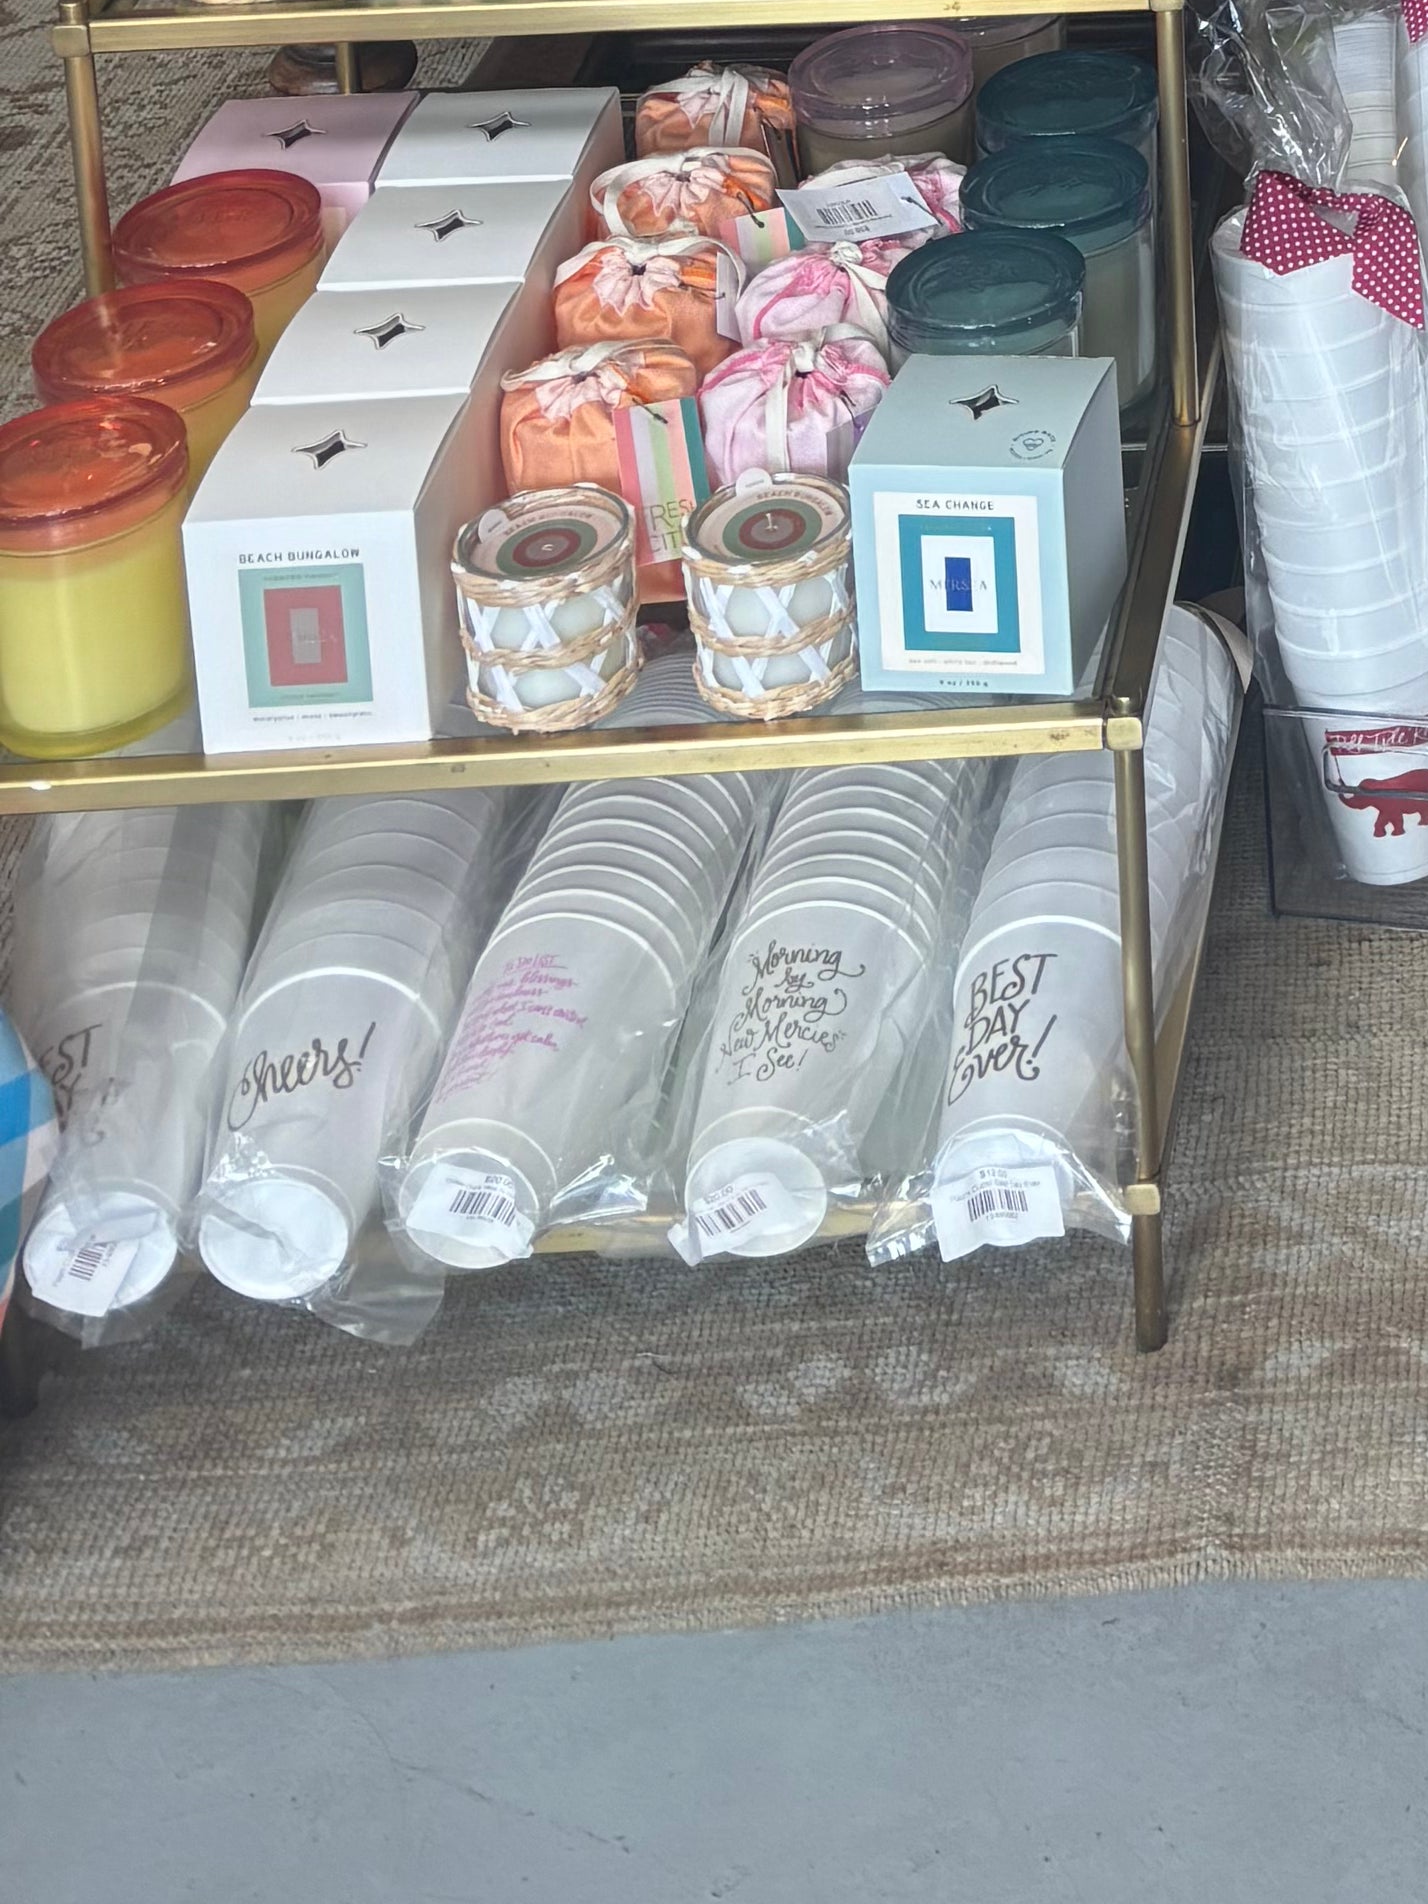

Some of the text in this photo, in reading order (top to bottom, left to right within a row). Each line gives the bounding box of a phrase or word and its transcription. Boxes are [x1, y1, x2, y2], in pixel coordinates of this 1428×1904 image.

[916, 498, 995, 511] SEA CHANGE
[238, 548, 361, 565] BEACH BUNGALOW
[741, 939, 866, 996] Morning
[773, 967, 815, 994] by
[963, 952, 1059, 1029] BEST
[733, 986, 848, 1033] Morning
[753, 1011, 838, 1053] Mercies
[965, 998, 1031, 1056] DAY
[227, 1021, 376, 1132] Cheers!
[727, 1046, 809, 1086] I See!
[947, 1013, 1058, 1107] Ever!
